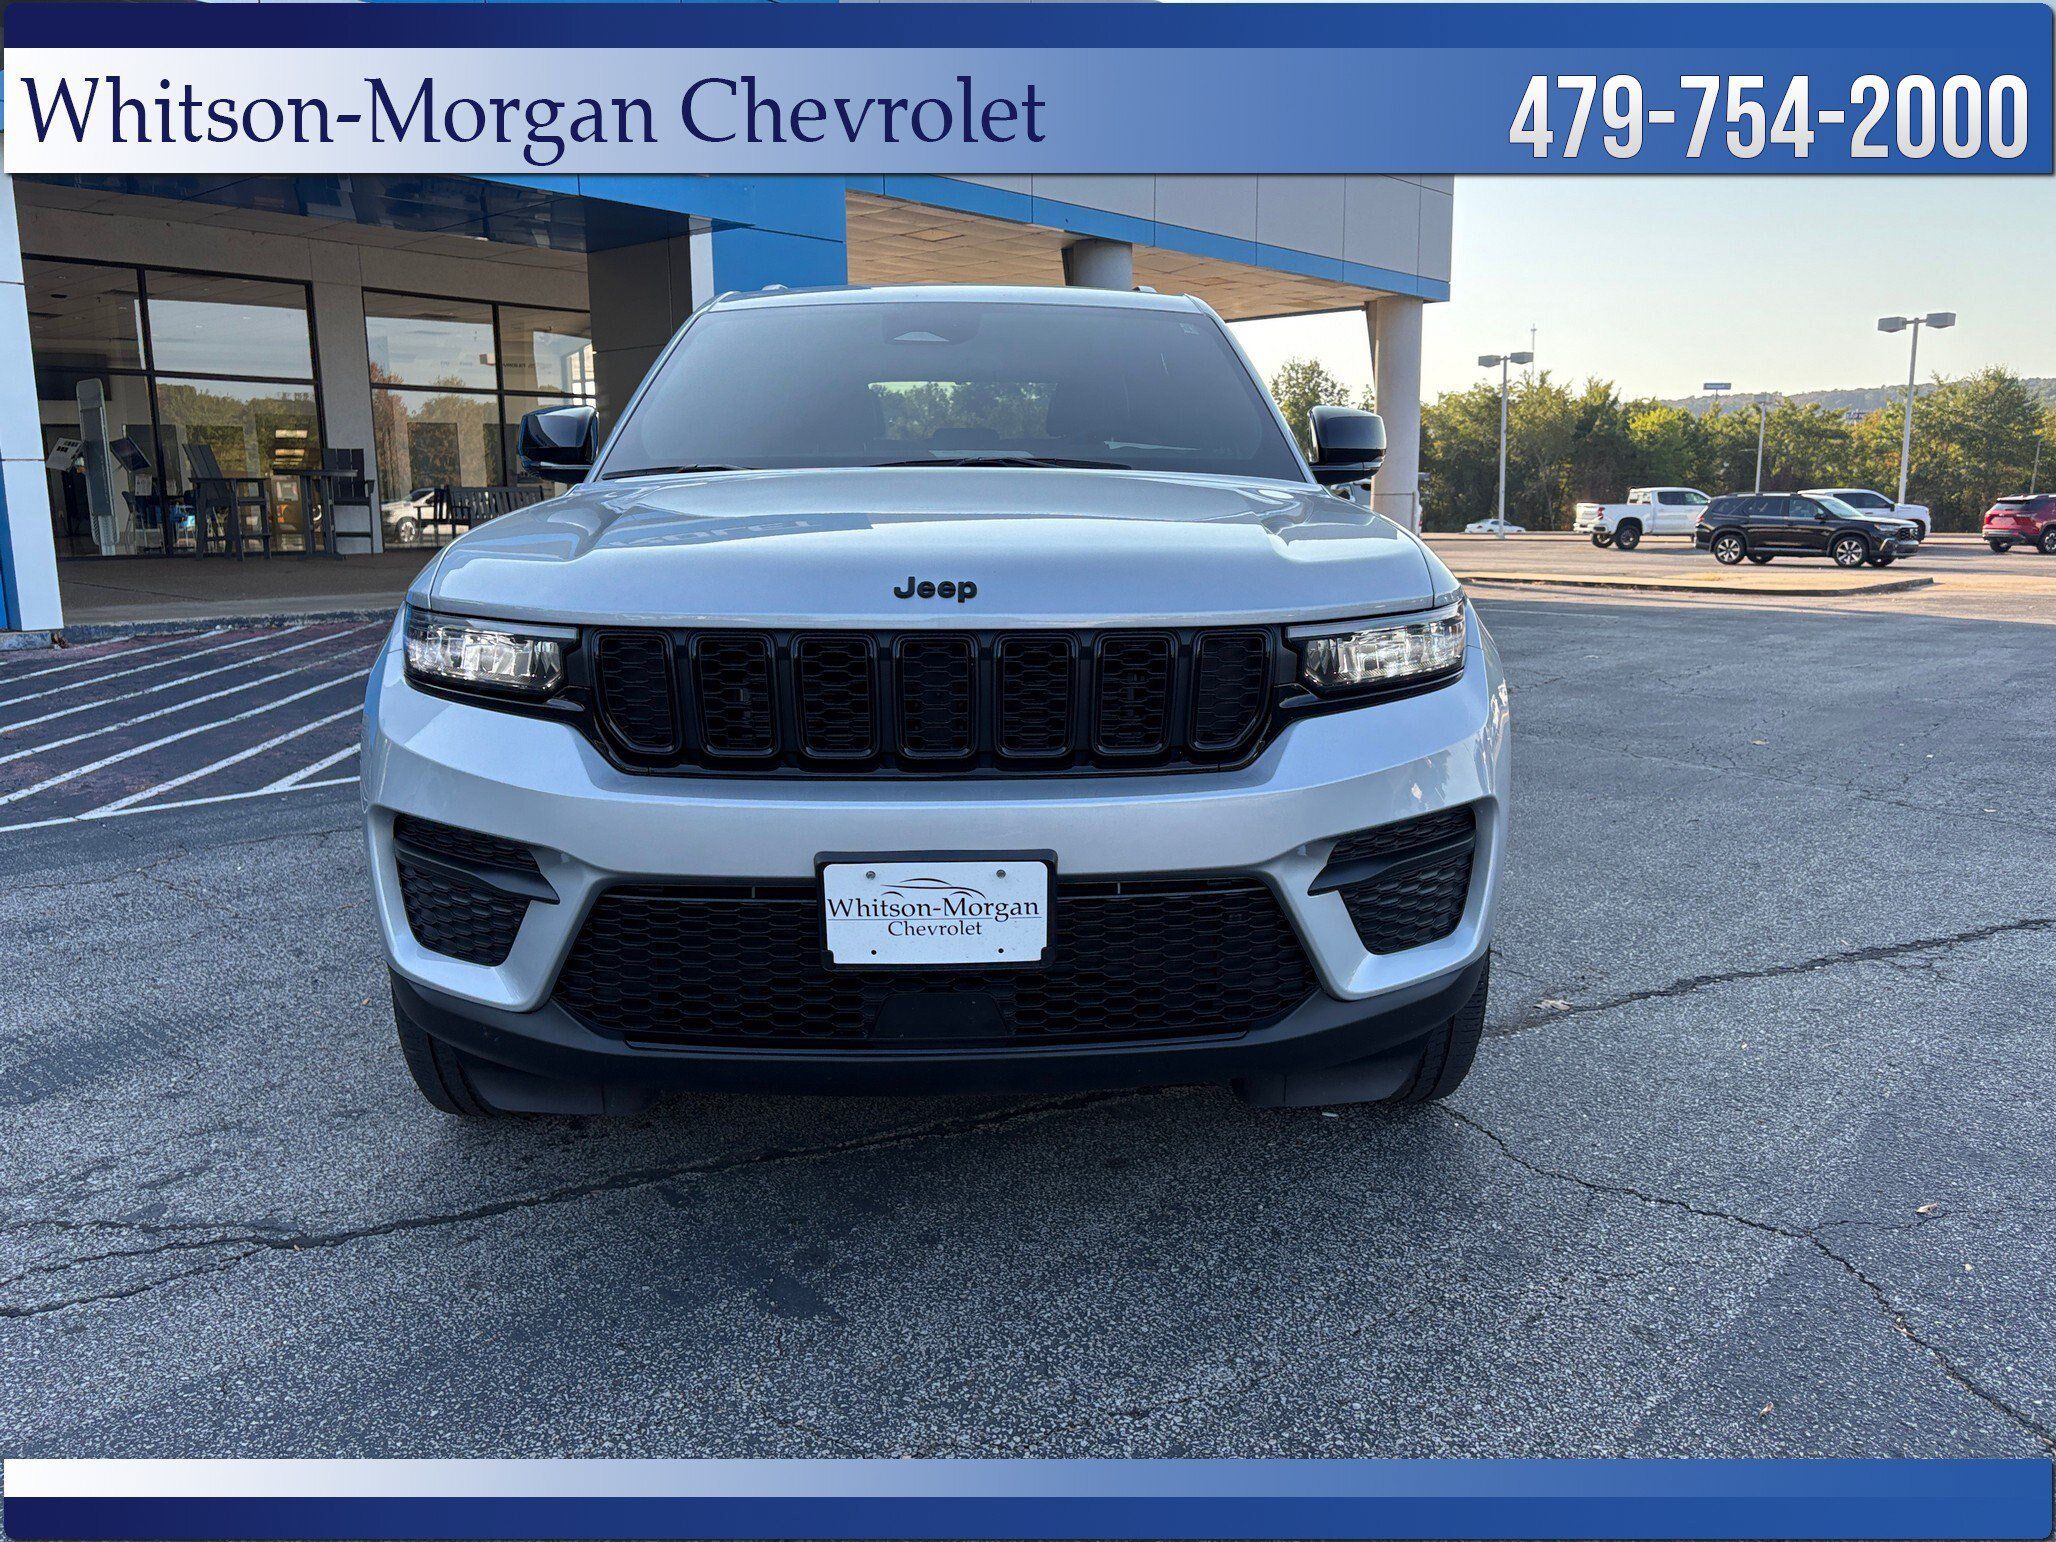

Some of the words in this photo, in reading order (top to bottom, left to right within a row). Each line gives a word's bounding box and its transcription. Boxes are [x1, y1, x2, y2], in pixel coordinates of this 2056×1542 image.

[893, 576, 978, 603] Jeep
[827, 897, 1040, 922] Whitson-Morgan
[888, 920, 983, 937] Chevrolet
